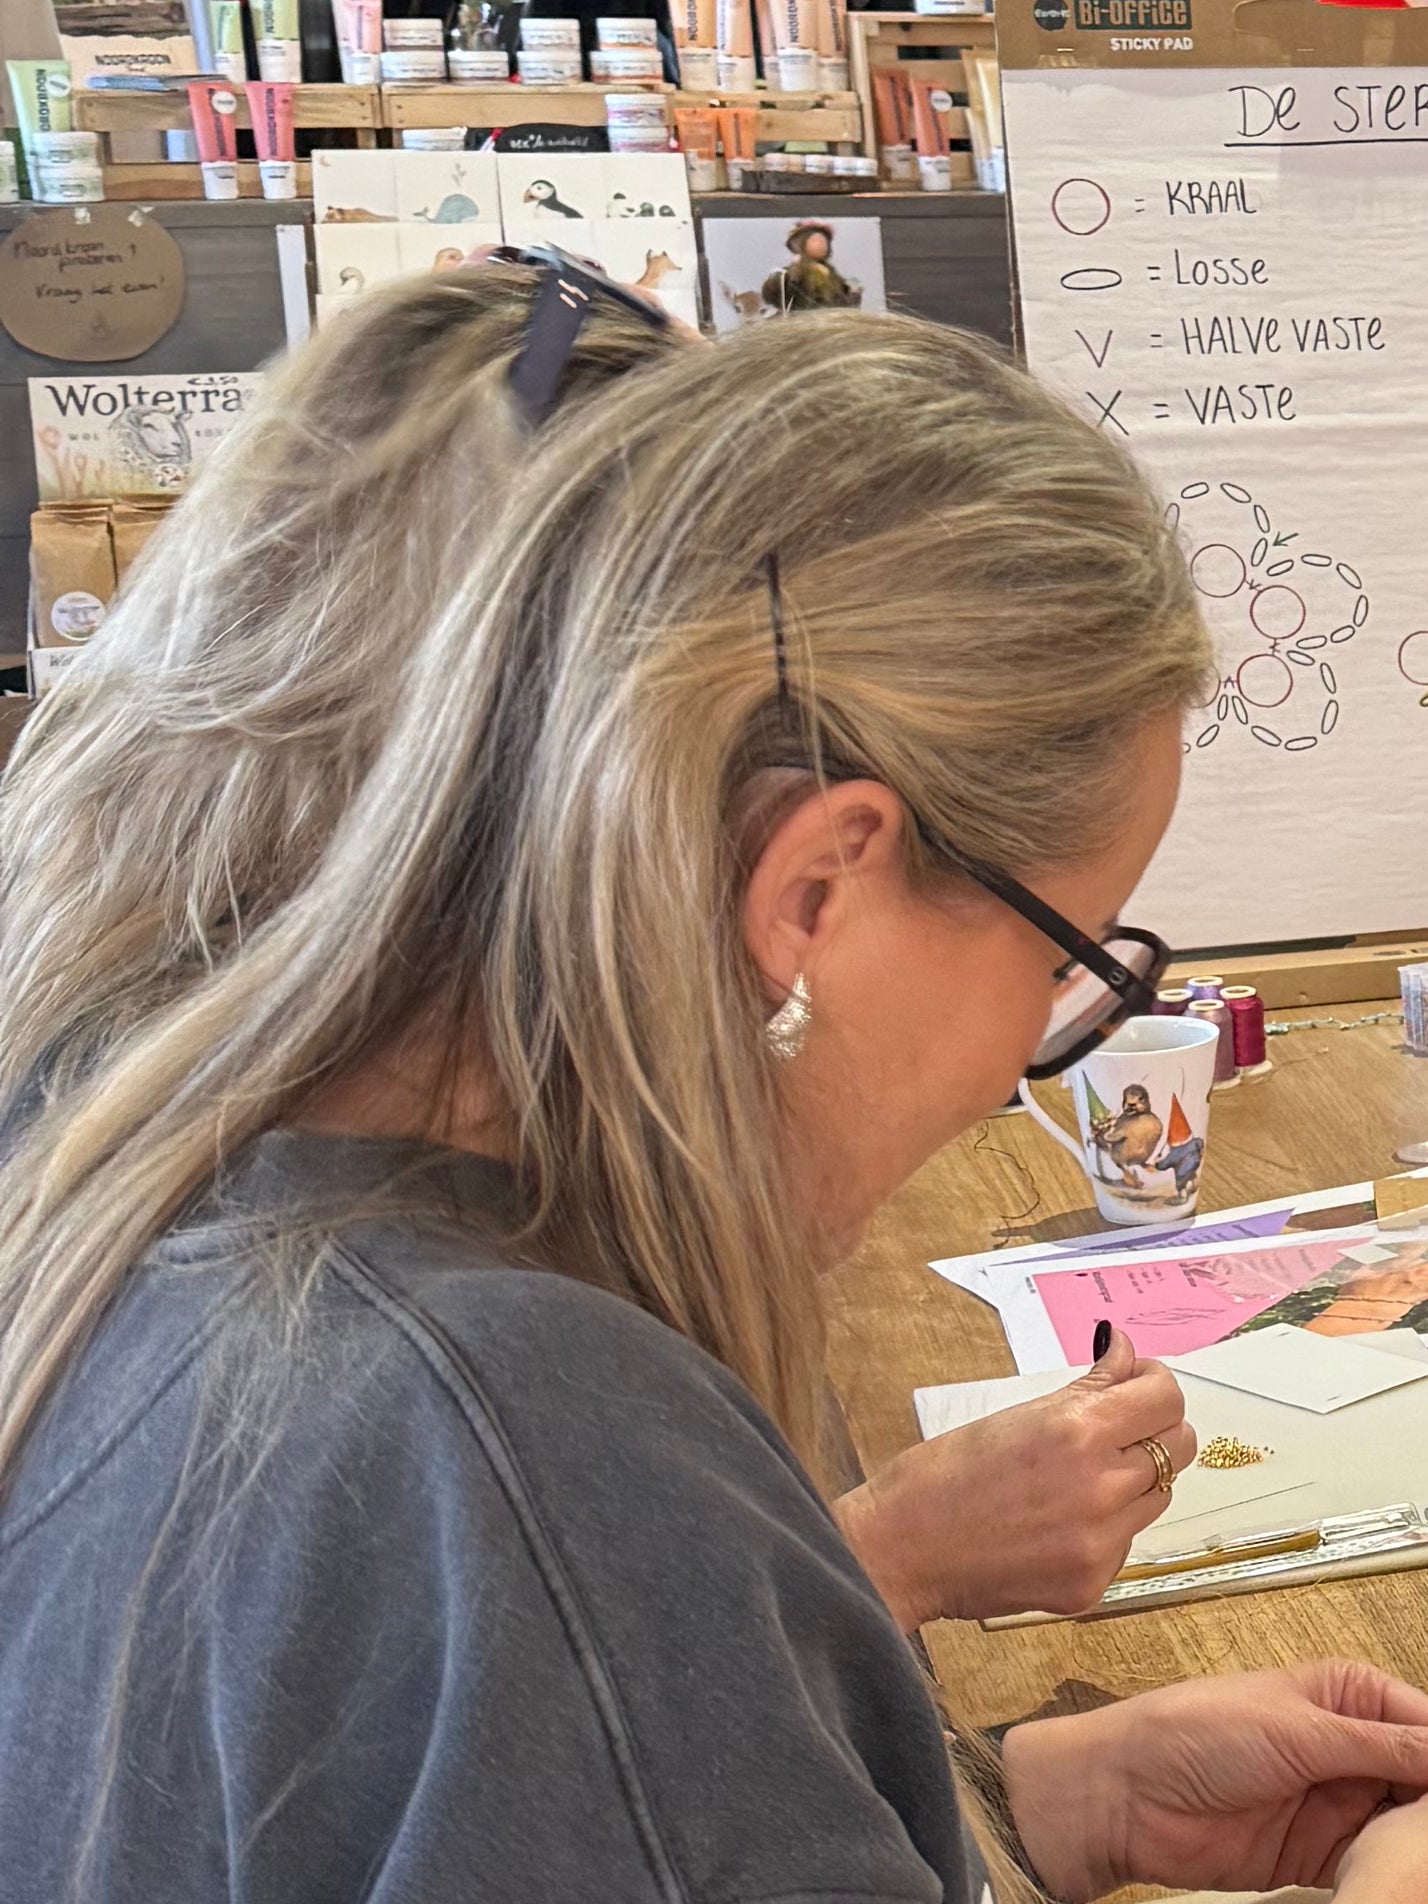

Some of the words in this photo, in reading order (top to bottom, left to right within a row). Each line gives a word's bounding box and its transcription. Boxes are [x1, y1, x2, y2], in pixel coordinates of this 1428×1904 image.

[1110, 37, 1162, 51] STICKY
[1163, 37, 1194, 51] PAD
[1165, 178, 1258, 216] KRAAL
